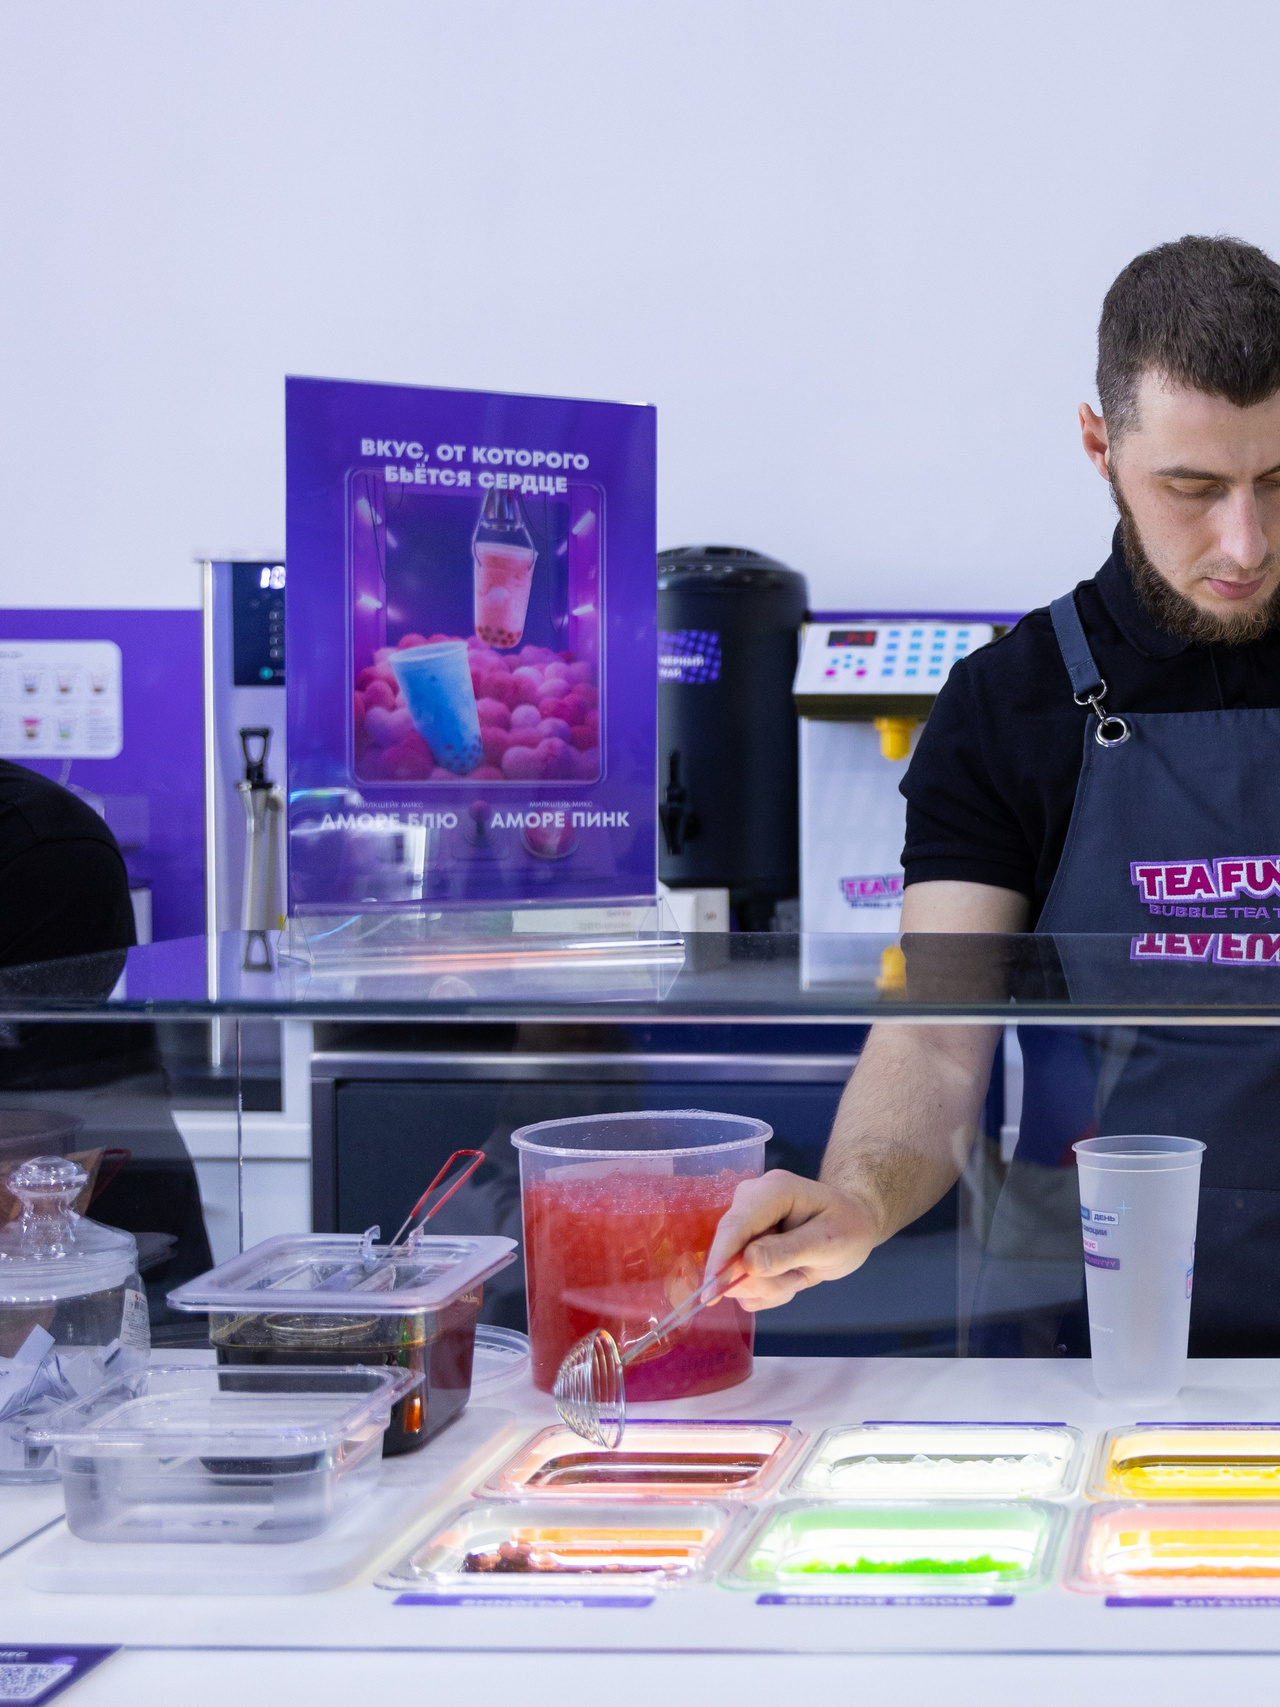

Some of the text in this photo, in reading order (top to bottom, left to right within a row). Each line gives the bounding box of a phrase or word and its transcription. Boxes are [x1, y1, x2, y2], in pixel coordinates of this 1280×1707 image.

[361, 438, 590, 471] ВКУС, ОТ КОТОРОГО
[385, 463, 568, 496] БЬЁТСЯ СЕРДЦЕ
[356, 801, 399, 809] МИЛКШЕЙК
[529, 799, 571, 808] МИЛКШЕЙК
[320, 812, 458, 830] АМОРЕ БЛЮ
[490, 811, 630, 828] АМОРЕ ПИНК
[845, 880, 884, 897] TEA
[1138, 865, 1214, 898] TEA
[1149, 904, 1227, 919] BUBBLE
[1230, 907, 1270, 919] TEA
[1094, 1213, 1116, 1222] ДЕНЬ
